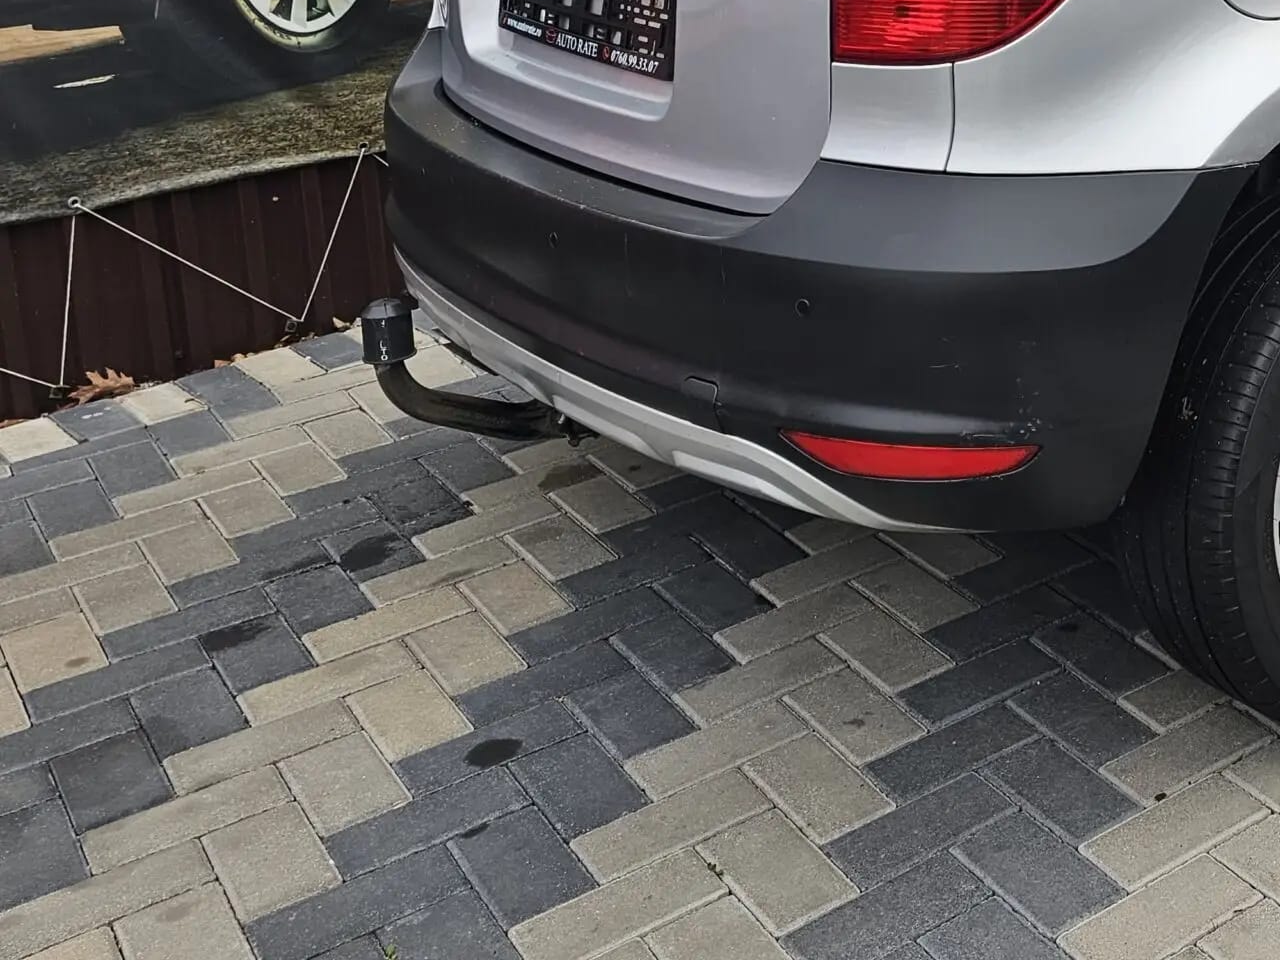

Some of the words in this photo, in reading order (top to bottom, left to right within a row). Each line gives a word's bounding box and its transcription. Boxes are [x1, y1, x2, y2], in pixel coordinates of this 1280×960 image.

[555, 33, 578, 50] AUTO
[578, 38, 599, 57] RATE
[610, 50, 660, 74] 0760.99.33.07
